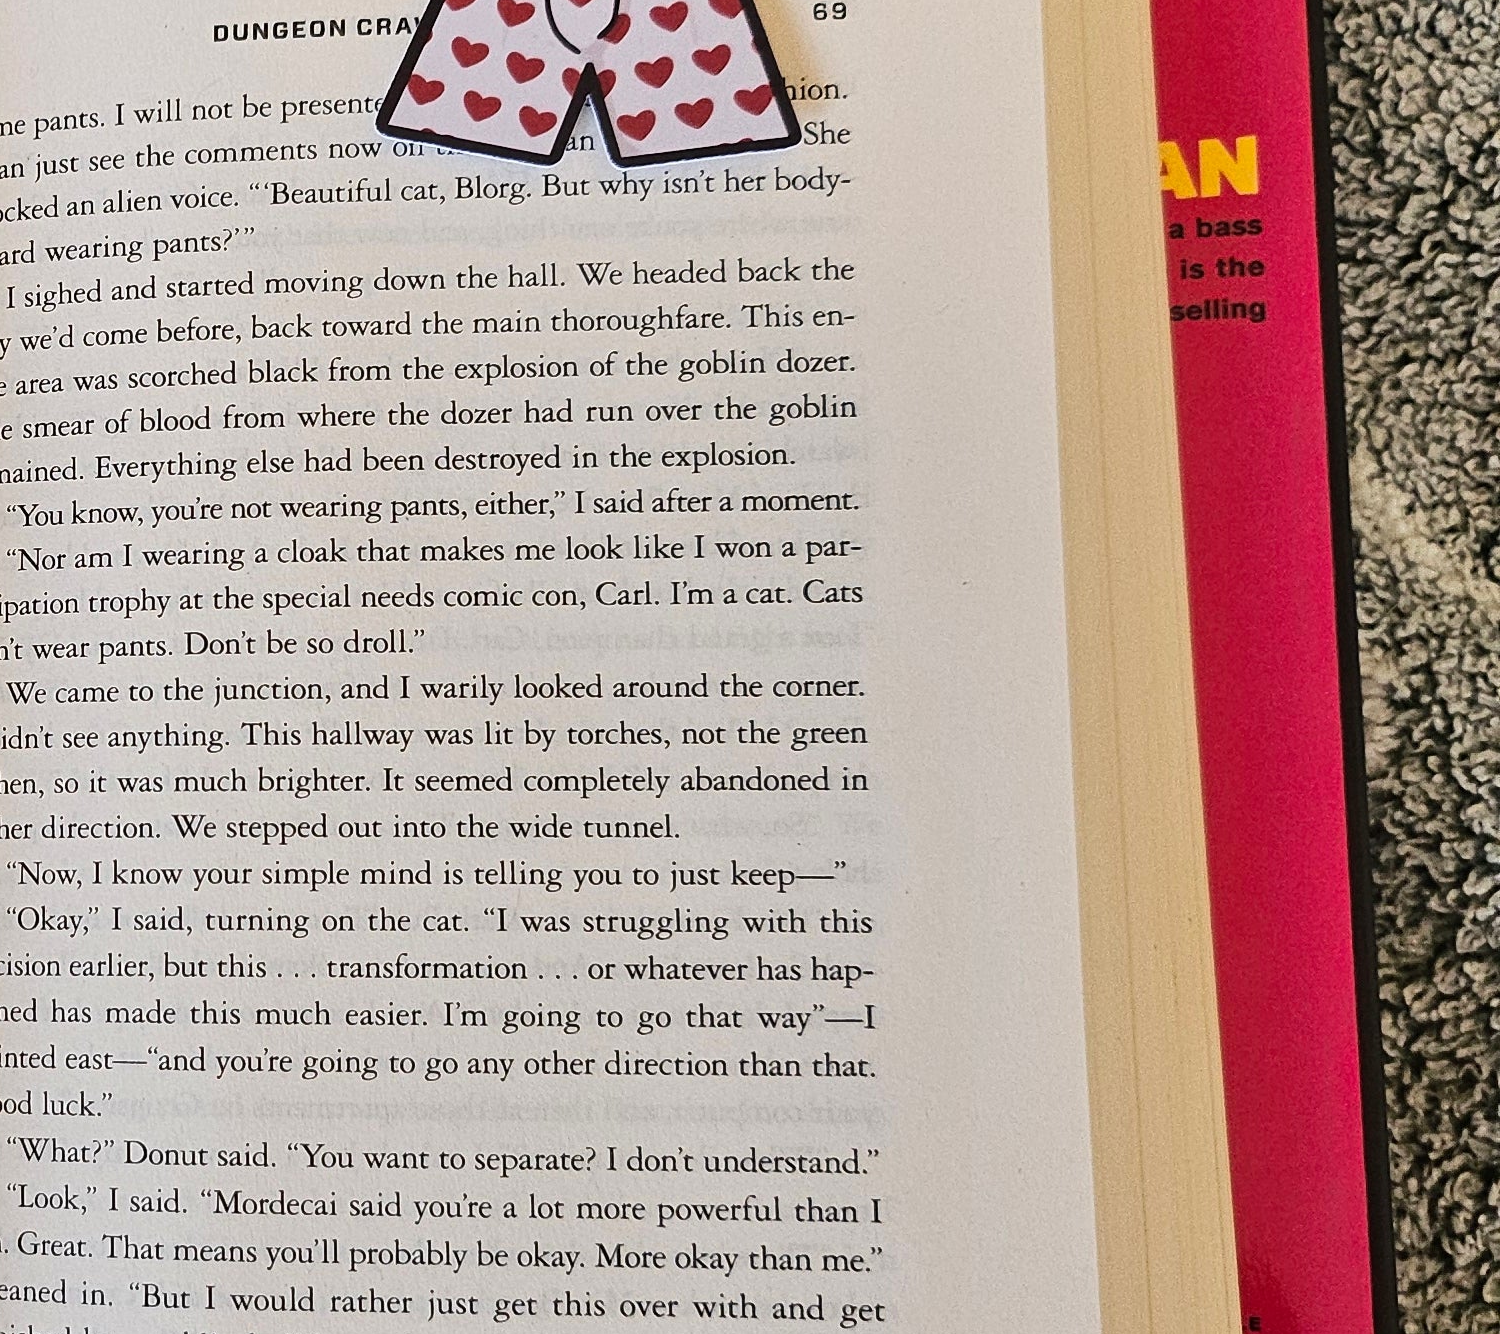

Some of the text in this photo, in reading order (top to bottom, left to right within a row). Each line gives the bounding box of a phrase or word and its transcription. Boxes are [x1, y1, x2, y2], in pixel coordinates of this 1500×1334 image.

[813, 2, 846, 20] 69
[214, 17, 419, 42] DUNGEON CRA
[33, 112, 104, 140] pants.
[115, 103, 124, 126] I
[133, 98, 182, 123] will
[192, 103, 233, 120] not
[243, 94, 271, 118] be
[1168, 218, 1263, 239] a bass
[44, 235, 143, 263] wearing
[1180, 257, 1265, 280] is the
[6, 257, 855, 312] I sighed and started moving down the hall. We headed back the
[1170, 298, 1267, 324] selling
[124, 1140, 209, 1166] Donut
[218, 1142, 276, 1167] said.
[362, 1152, 429, 1169] want
[439, 1151, 465, 1170] to
[475, 1147, 596, 1178] separate?
[607, 1146, 617, 1171] I
